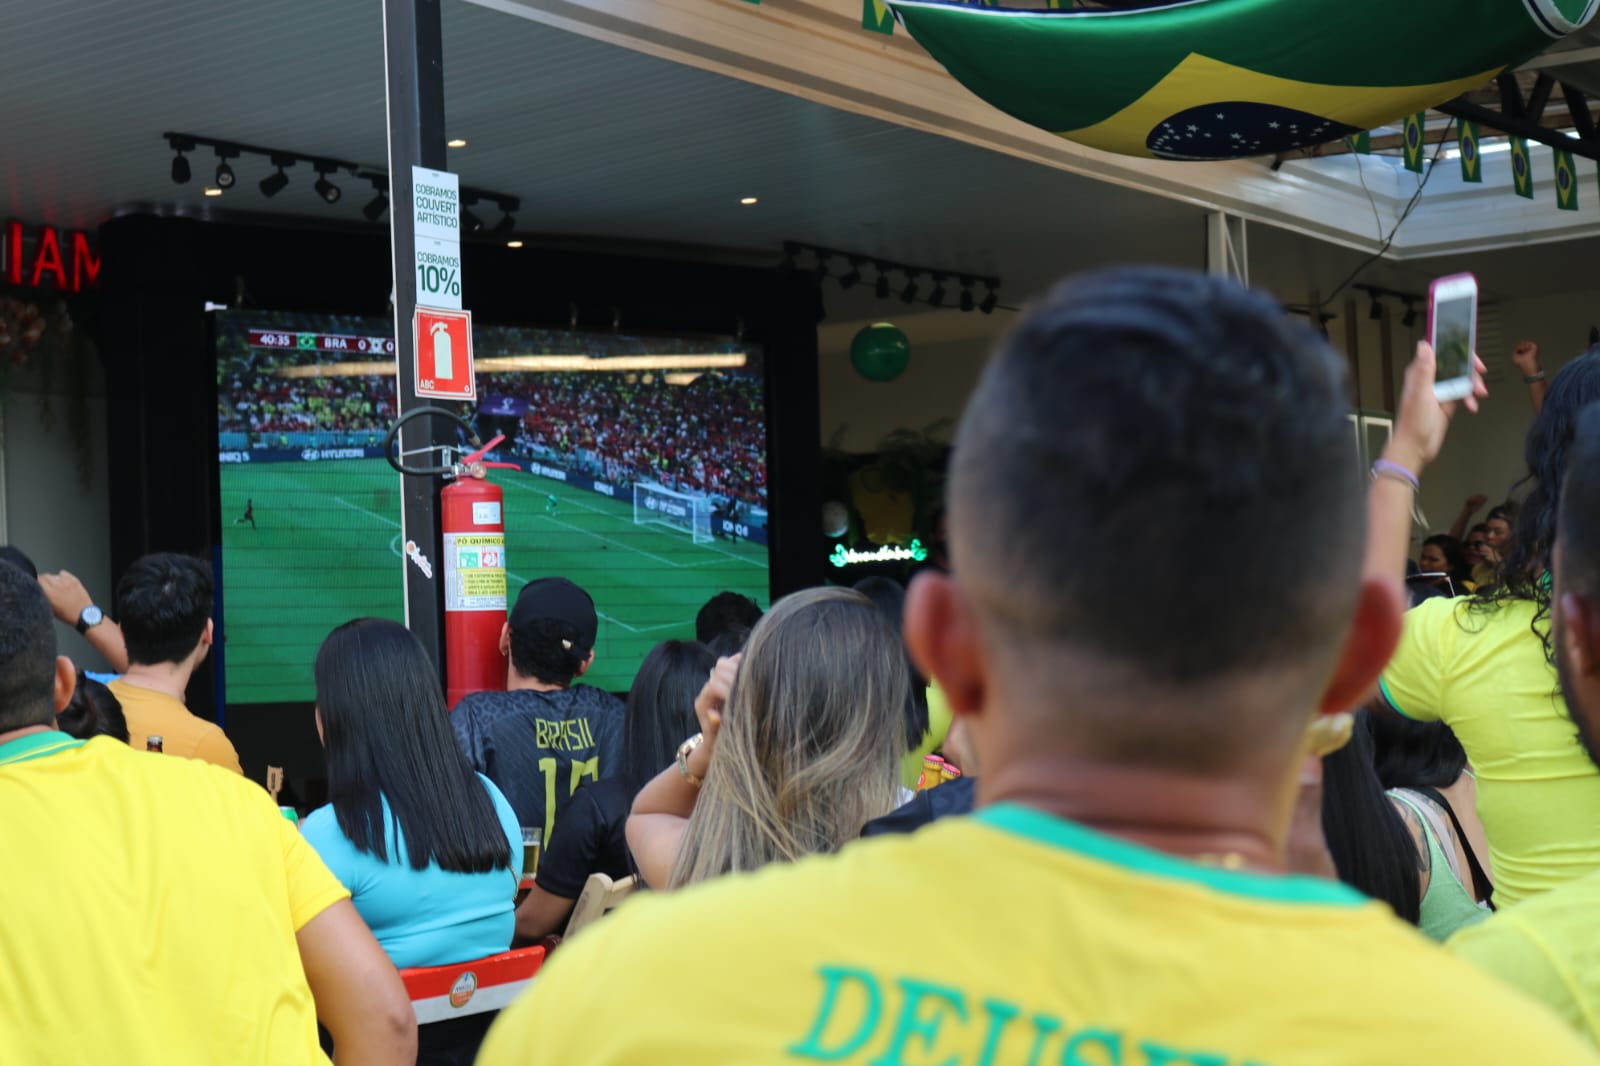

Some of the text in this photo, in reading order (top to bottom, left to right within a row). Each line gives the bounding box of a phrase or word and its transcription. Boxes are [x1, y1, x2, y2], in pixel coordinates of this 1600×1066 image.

[415, 183, 457, 200] COBRAMOS
[415, 196, 457, 214] COUVERT
[416, 211, 458, 228] ARTÍSTICO
[416, 251, 459, 268] COBRAMOS
[417, 264, 460, 296] 10%
[259, 334, 290, 346] 40:35
[324, 337, 347, 349] BRA
[357, 339, 367, 350] 0
[420, 378, 435, 390] ABC
[535, 717, 595, 751] BRASIL
